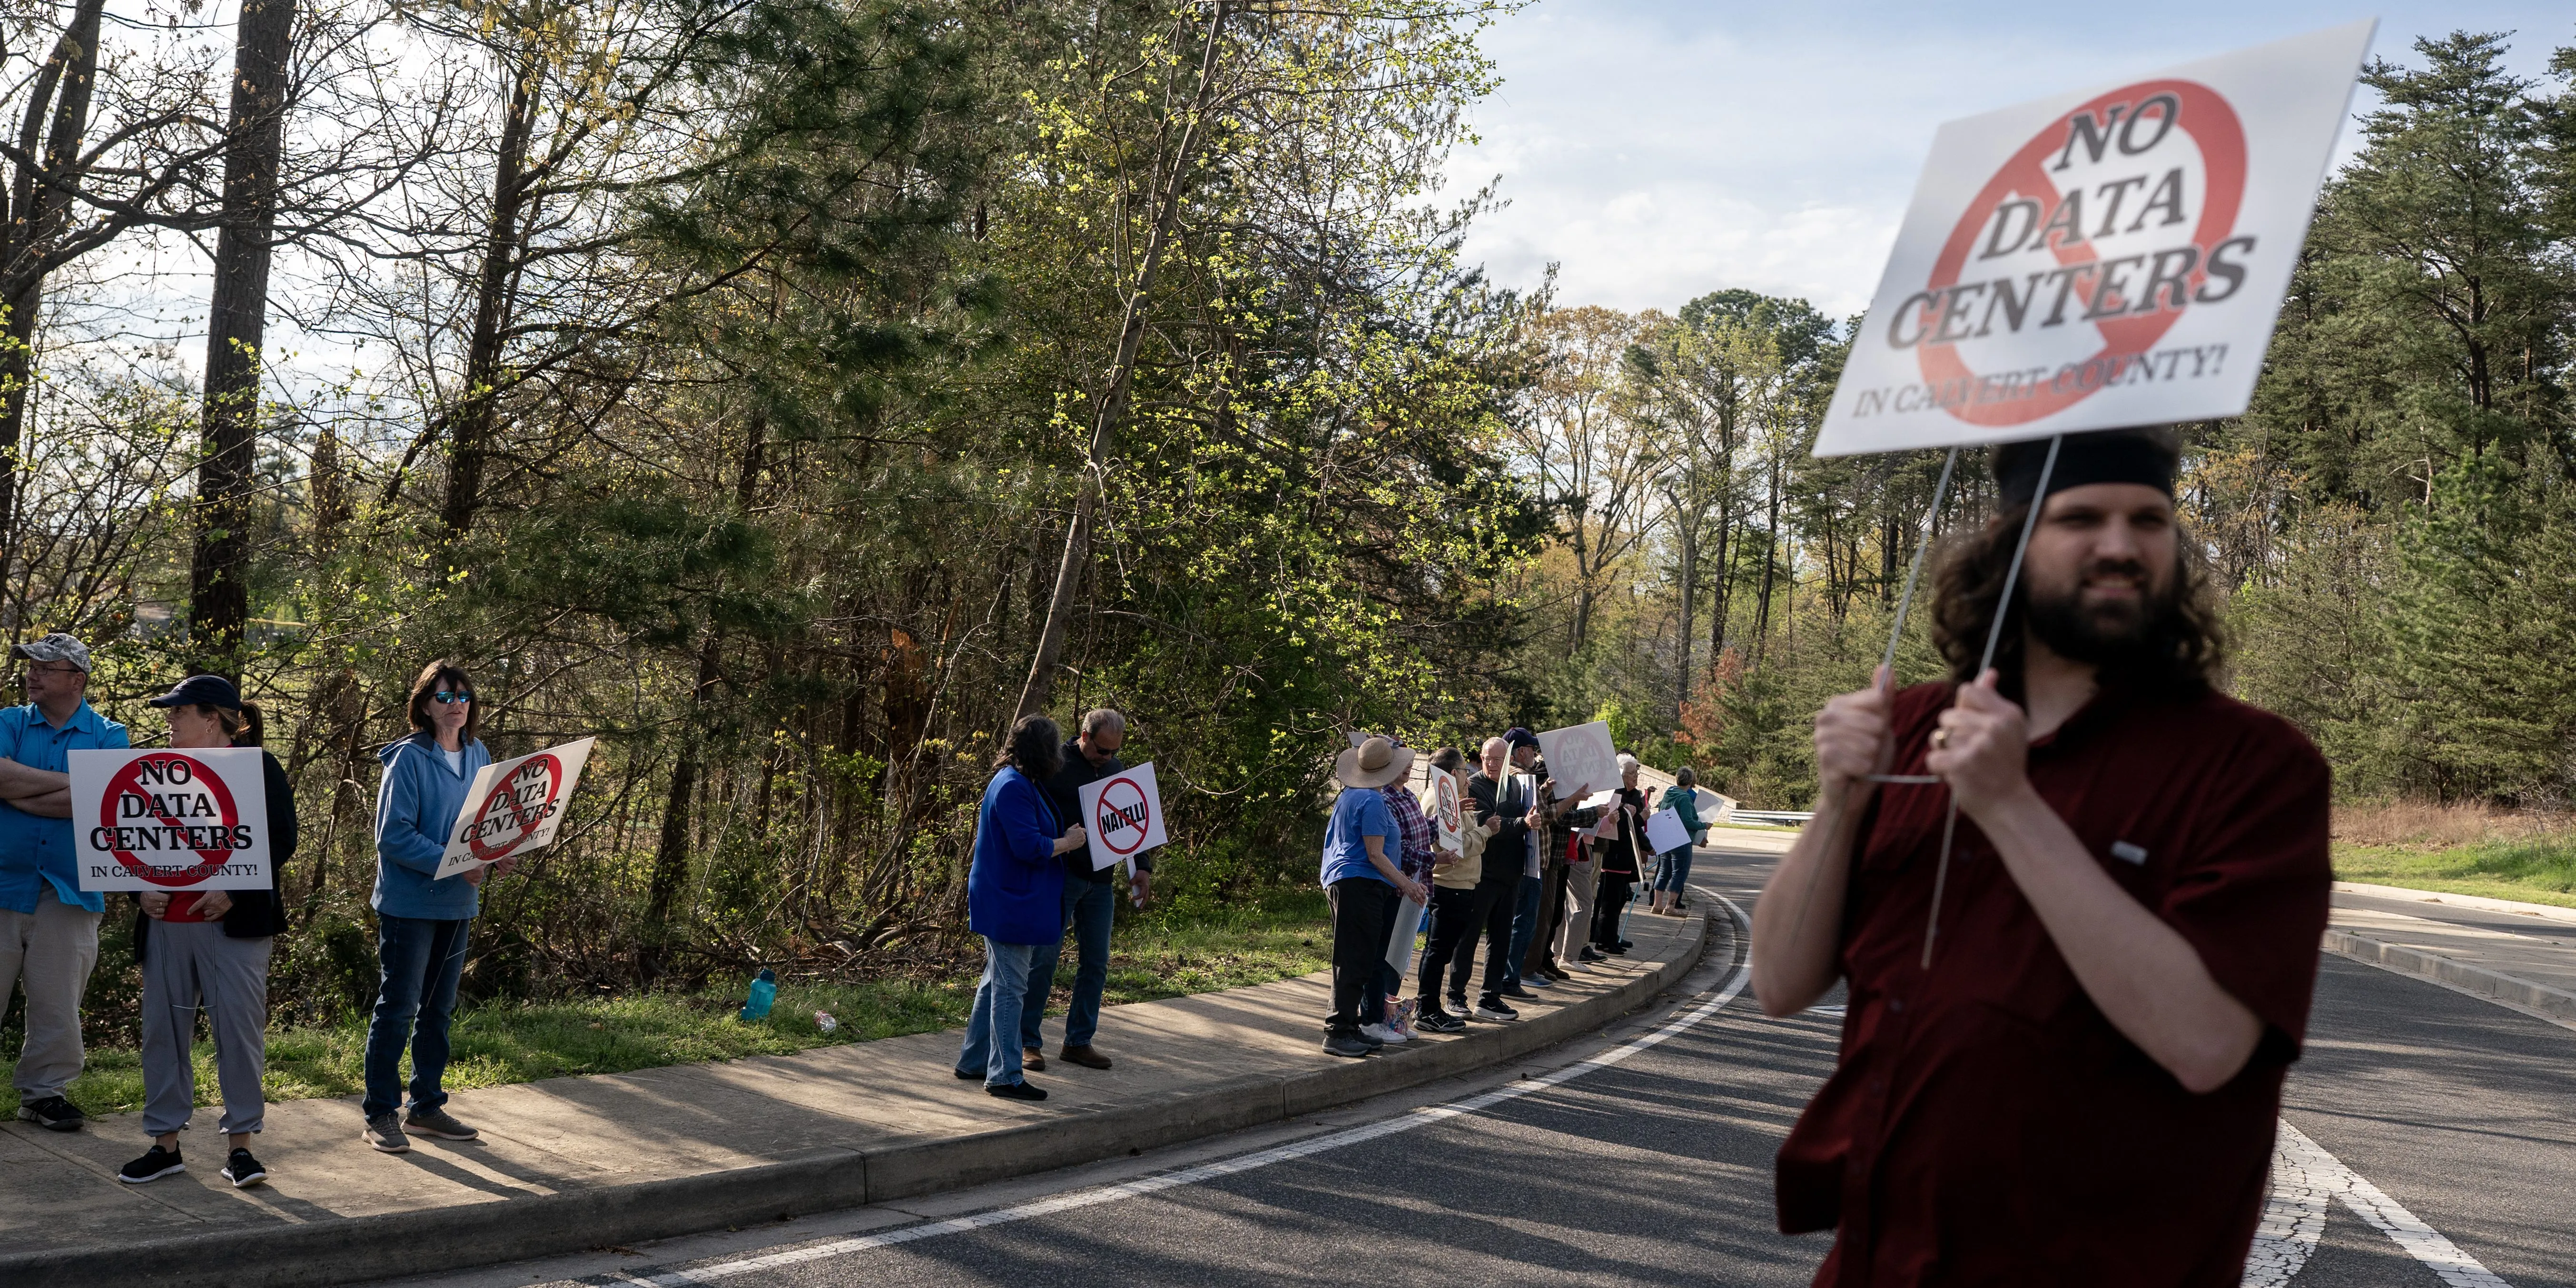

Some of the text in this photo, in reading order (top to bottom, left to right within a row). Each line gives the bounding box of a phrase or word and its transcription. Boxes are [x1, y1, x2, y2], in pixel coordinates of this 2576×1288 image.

[2051, 92, 2179, 172] NO
[1978, 167, 2187, 262] DATA
[1886, 234, 2258, 351] CENTERS
[1852, 344, 2230, 418] IN CALVERT COUNTY!
[139, 760, 191, 785] NO
[513, 758, 549, 784] NO
[489, 780, 547, 813] DATA
[1441, 795, 1455, 813] DATA
[1442, 783, 1451, 797] NO
[120, 793, 217, 818] DATA
[1101, 801, 1146, 835] NATELLI
[1439, 807, 1461, 829] CENTERS
[460, 798, 561, 844] CENTERS
[90, 825, 253, 852] CENTERS
[448, 827, 551, 867] IN CALVERT COUNTY!
[90, 864, 258, 877] IN CALVERT COUNTY!
